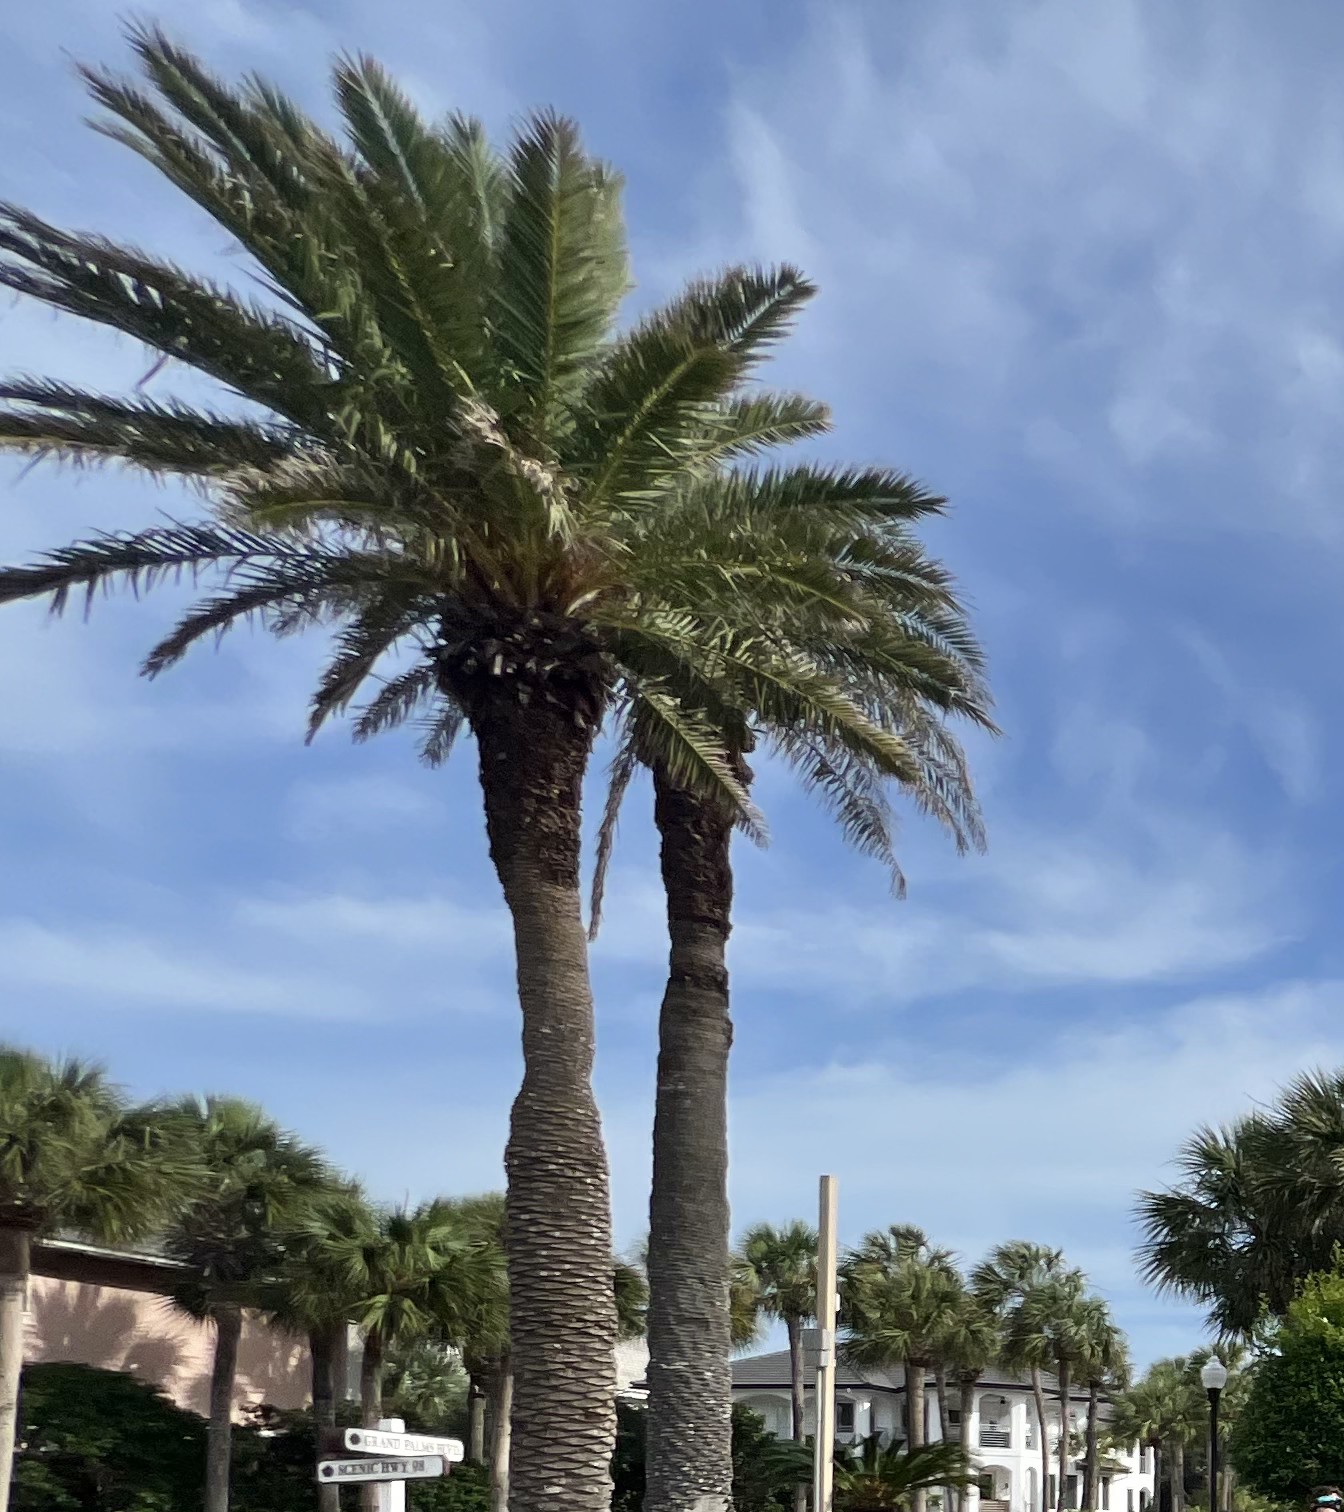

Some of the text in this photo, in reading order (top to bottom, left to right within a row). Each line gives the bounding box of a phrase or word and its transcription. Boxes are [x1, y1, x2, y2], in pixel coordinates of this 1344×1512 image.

[364, 1435, 401, 1450] GRAND
[404, 1439, 435, 1452] PALMS
[338, 1463, 379, 1476] SCENIC
[381, 1461, 408, 1474] HWY
